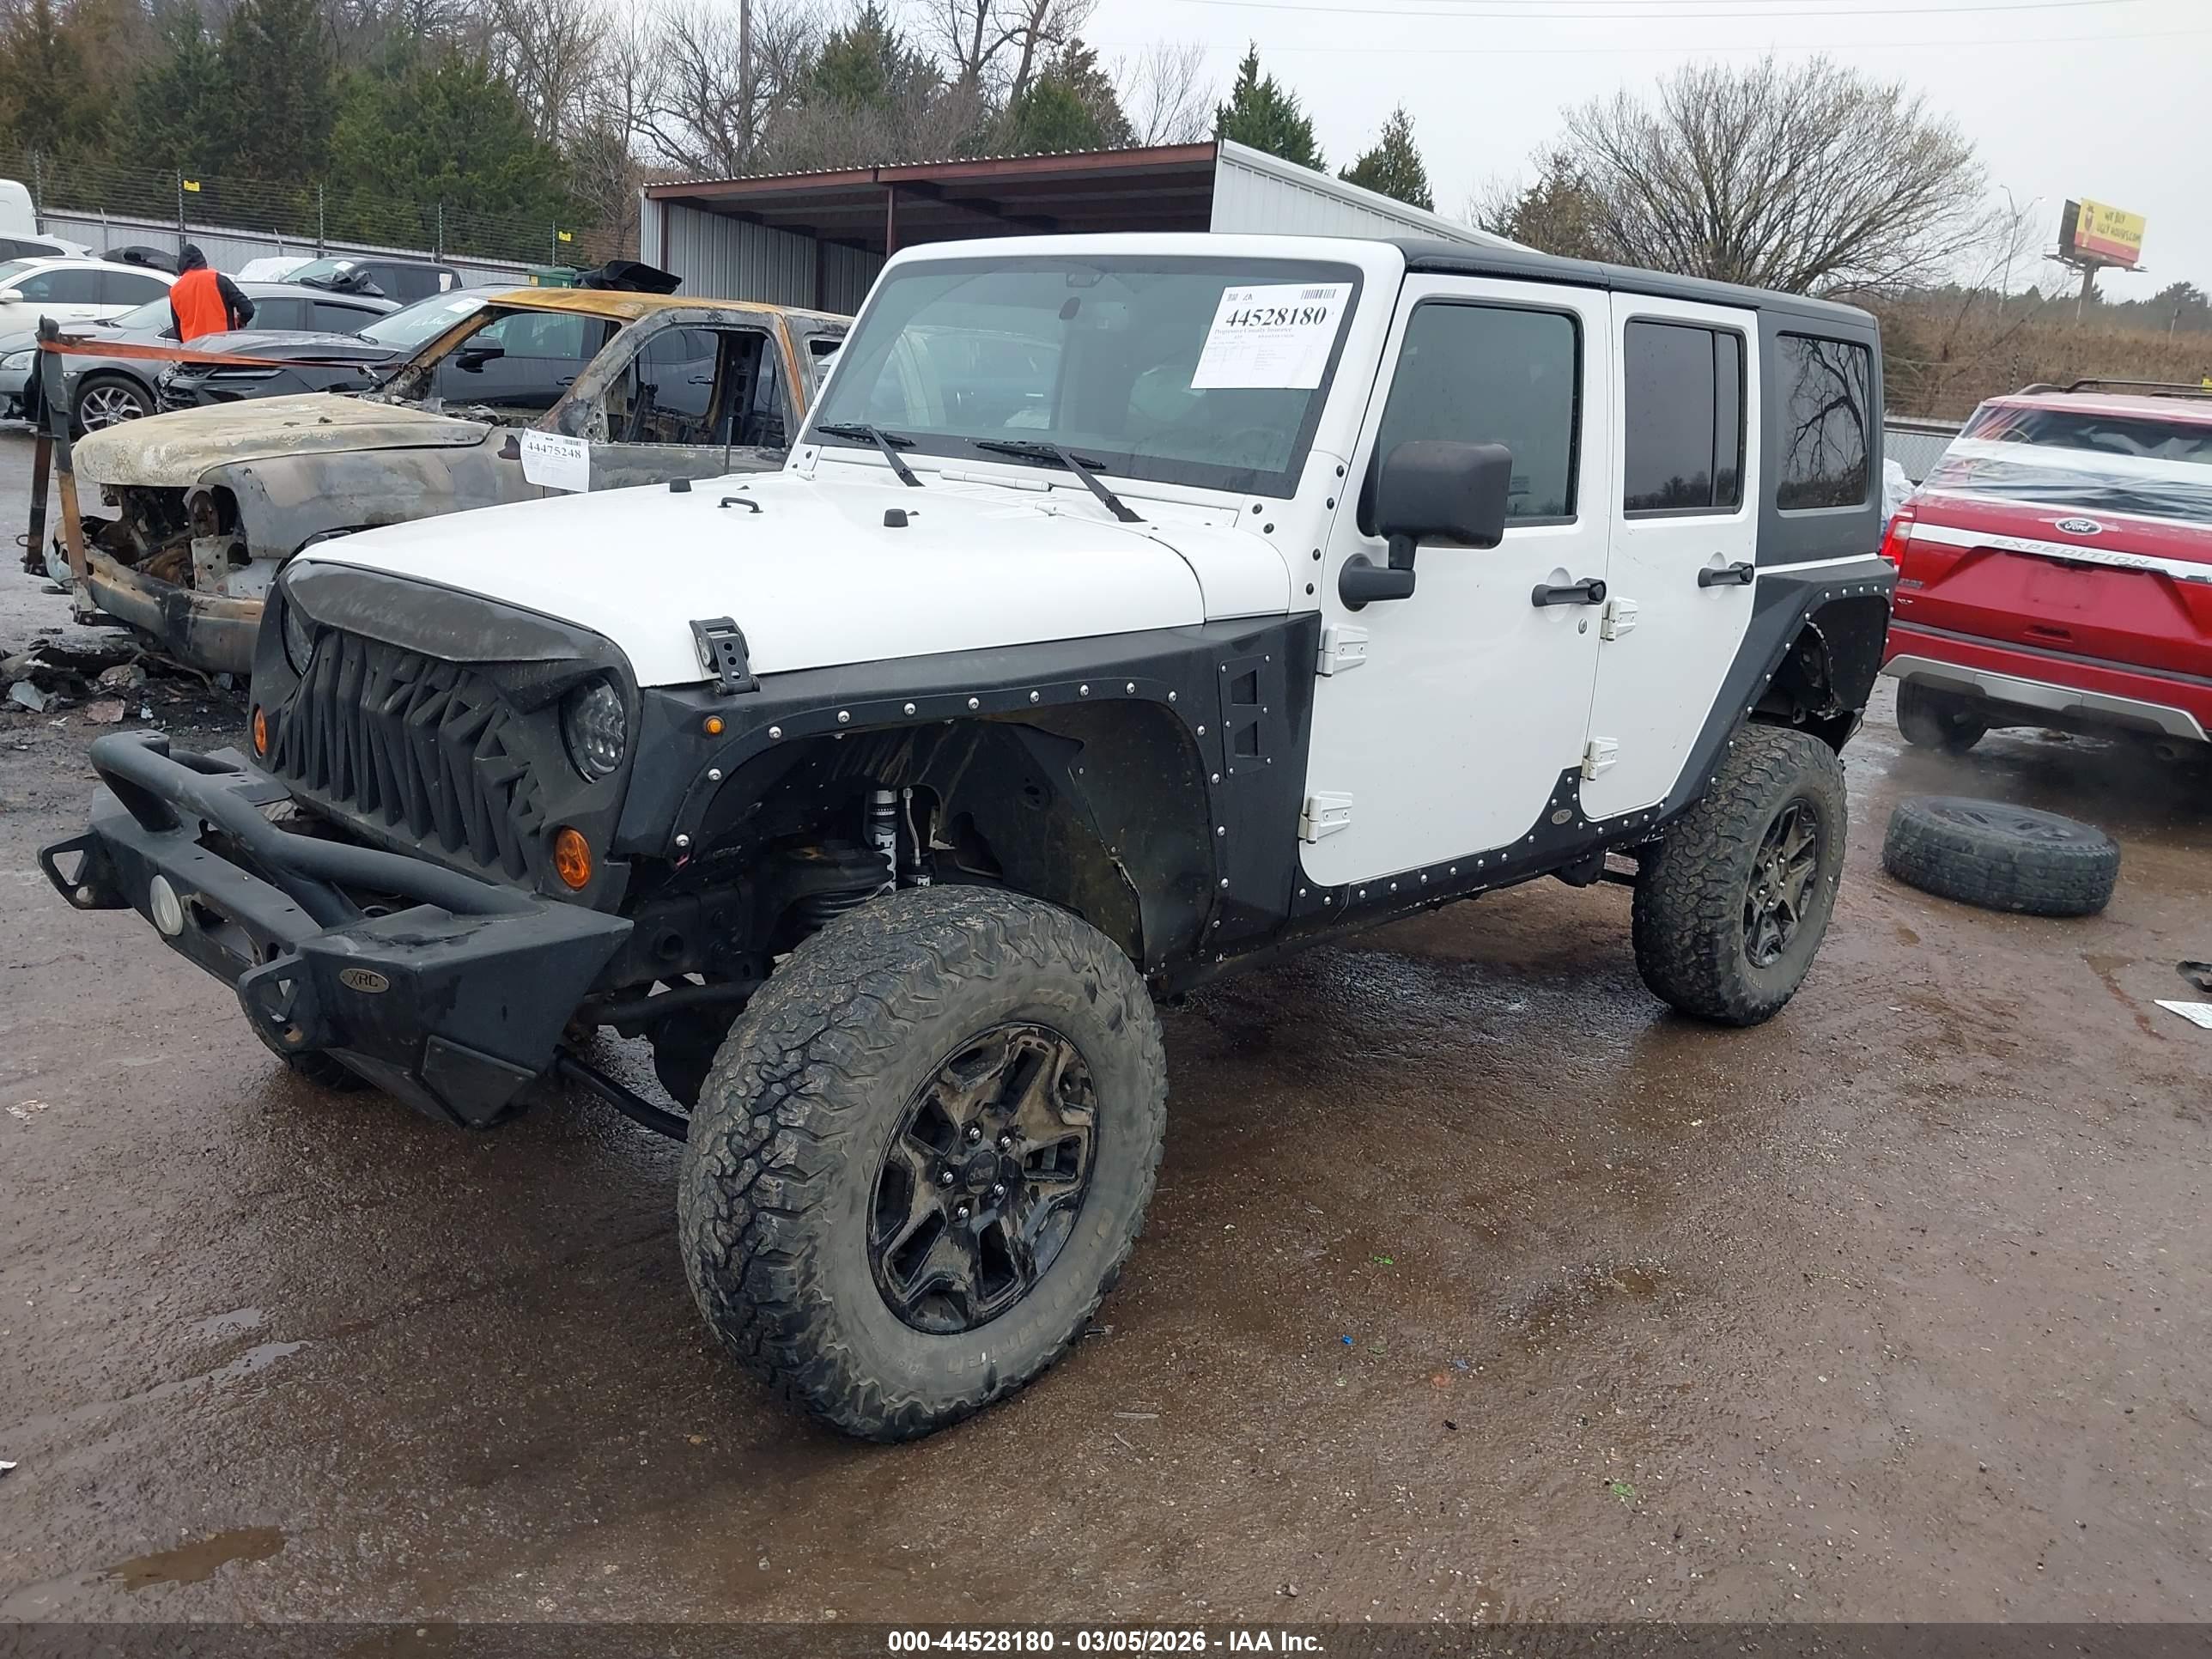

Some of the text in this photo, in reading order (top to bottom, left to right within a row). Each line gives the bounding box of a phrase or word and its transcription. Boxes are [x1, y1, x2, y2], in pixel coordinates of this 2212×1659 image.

[1225, 307, 1328, 327] 44528180
[527, 442, 581, 459] 44475248
[2063, 520, 2093, 533] Ford
[1990, 538, 2151, 566] EXPEDITION
[349, 970, 378, 987] XRC
